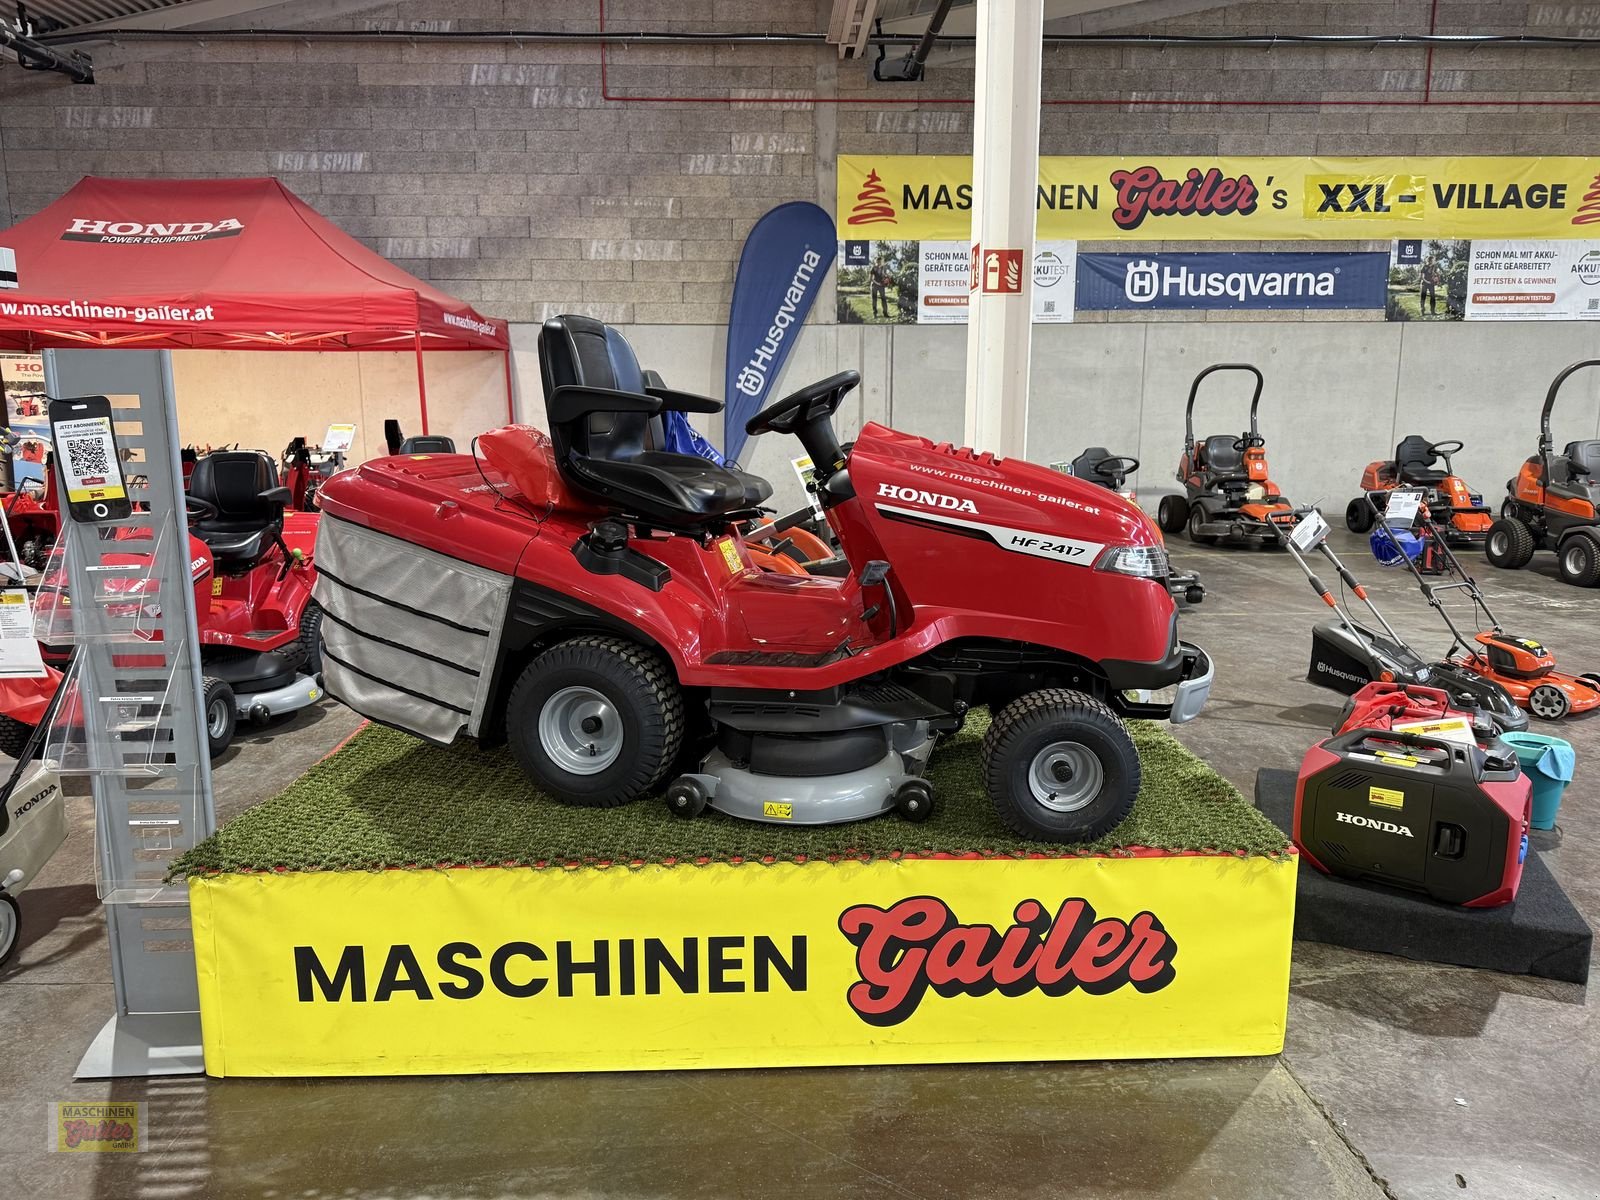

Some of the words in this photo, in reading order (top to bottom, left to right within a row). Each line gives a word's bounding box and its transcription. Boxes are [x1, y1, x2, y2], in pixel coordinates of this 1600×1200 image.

[1433, 184, 1568, 209] VILLAGE
[66, 218, 245, 236] HONDA
[100, 235, 142, 243] POWER
[143, 233, 207, 244] EQUIPMENT
[925, 253, 951, 261] SCHON
[1474, 261, 1502, 271] GERÄTE
[1503, 262, 1552, 271] GEARBEITET?
[1475, 251, 1500, 259] SCHON
[1502, 251, 1519, 259] MAL
[1519, 251, 1533, 259] MIT
[1533, 251, 1558, 259] AKKU-
[925, 261, 953, 272] GERÄTE
[1473, 277, 1491, 285] JETZT
[1493, 277, 1516, 285] TESTEN
[1523, 277, 1557, 285] GEWINNEN
[0, 300, 215, 323] w.maschinen-gailer.at
[749, 249, 821, 373] Husqvarna
[877, 483, 980, 515] HONDA
[909, 463, 1101, 516] www.maschinen-gailer.at
[1011, 535, 1038, 548] HF
[1039, 541, 1086, 557] 2417
[1325, 664, 1369, 685] Husqvarna
[14, 784, 58, 820] HONDA
[1336, 811, 1415, 838] HONDA
[293, 934, 808, 1003] MASCHINEN
[837, 895, 1178, 1027] Gailer
